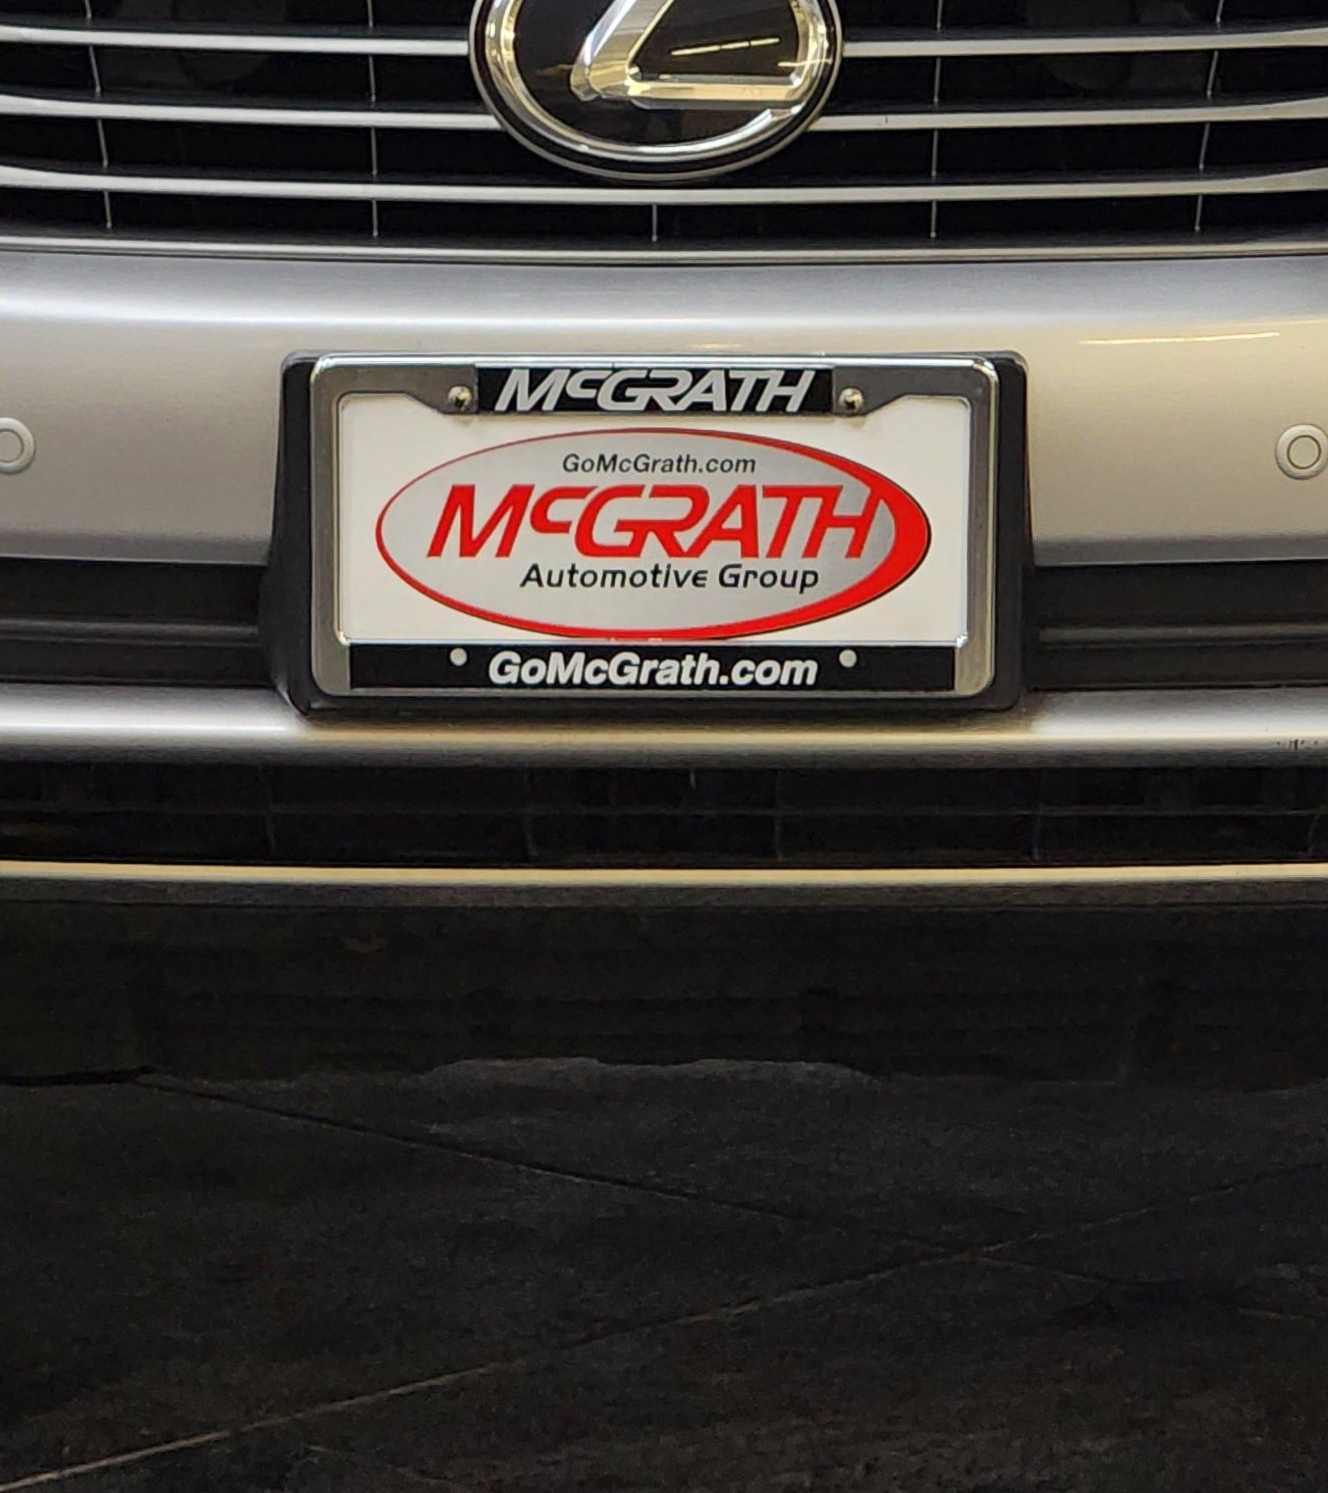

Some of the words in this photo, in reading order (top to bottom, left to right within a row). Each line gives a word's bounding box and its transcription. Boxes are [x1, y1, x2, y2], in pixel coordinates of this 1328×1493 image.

[562, 452, 756, 475] GoMcGrath.com
[520, 563, 709, 589] Automotive
[718, 563, 819, 595] Group
[488, 650, 818, 687] GoMcGrath.com
